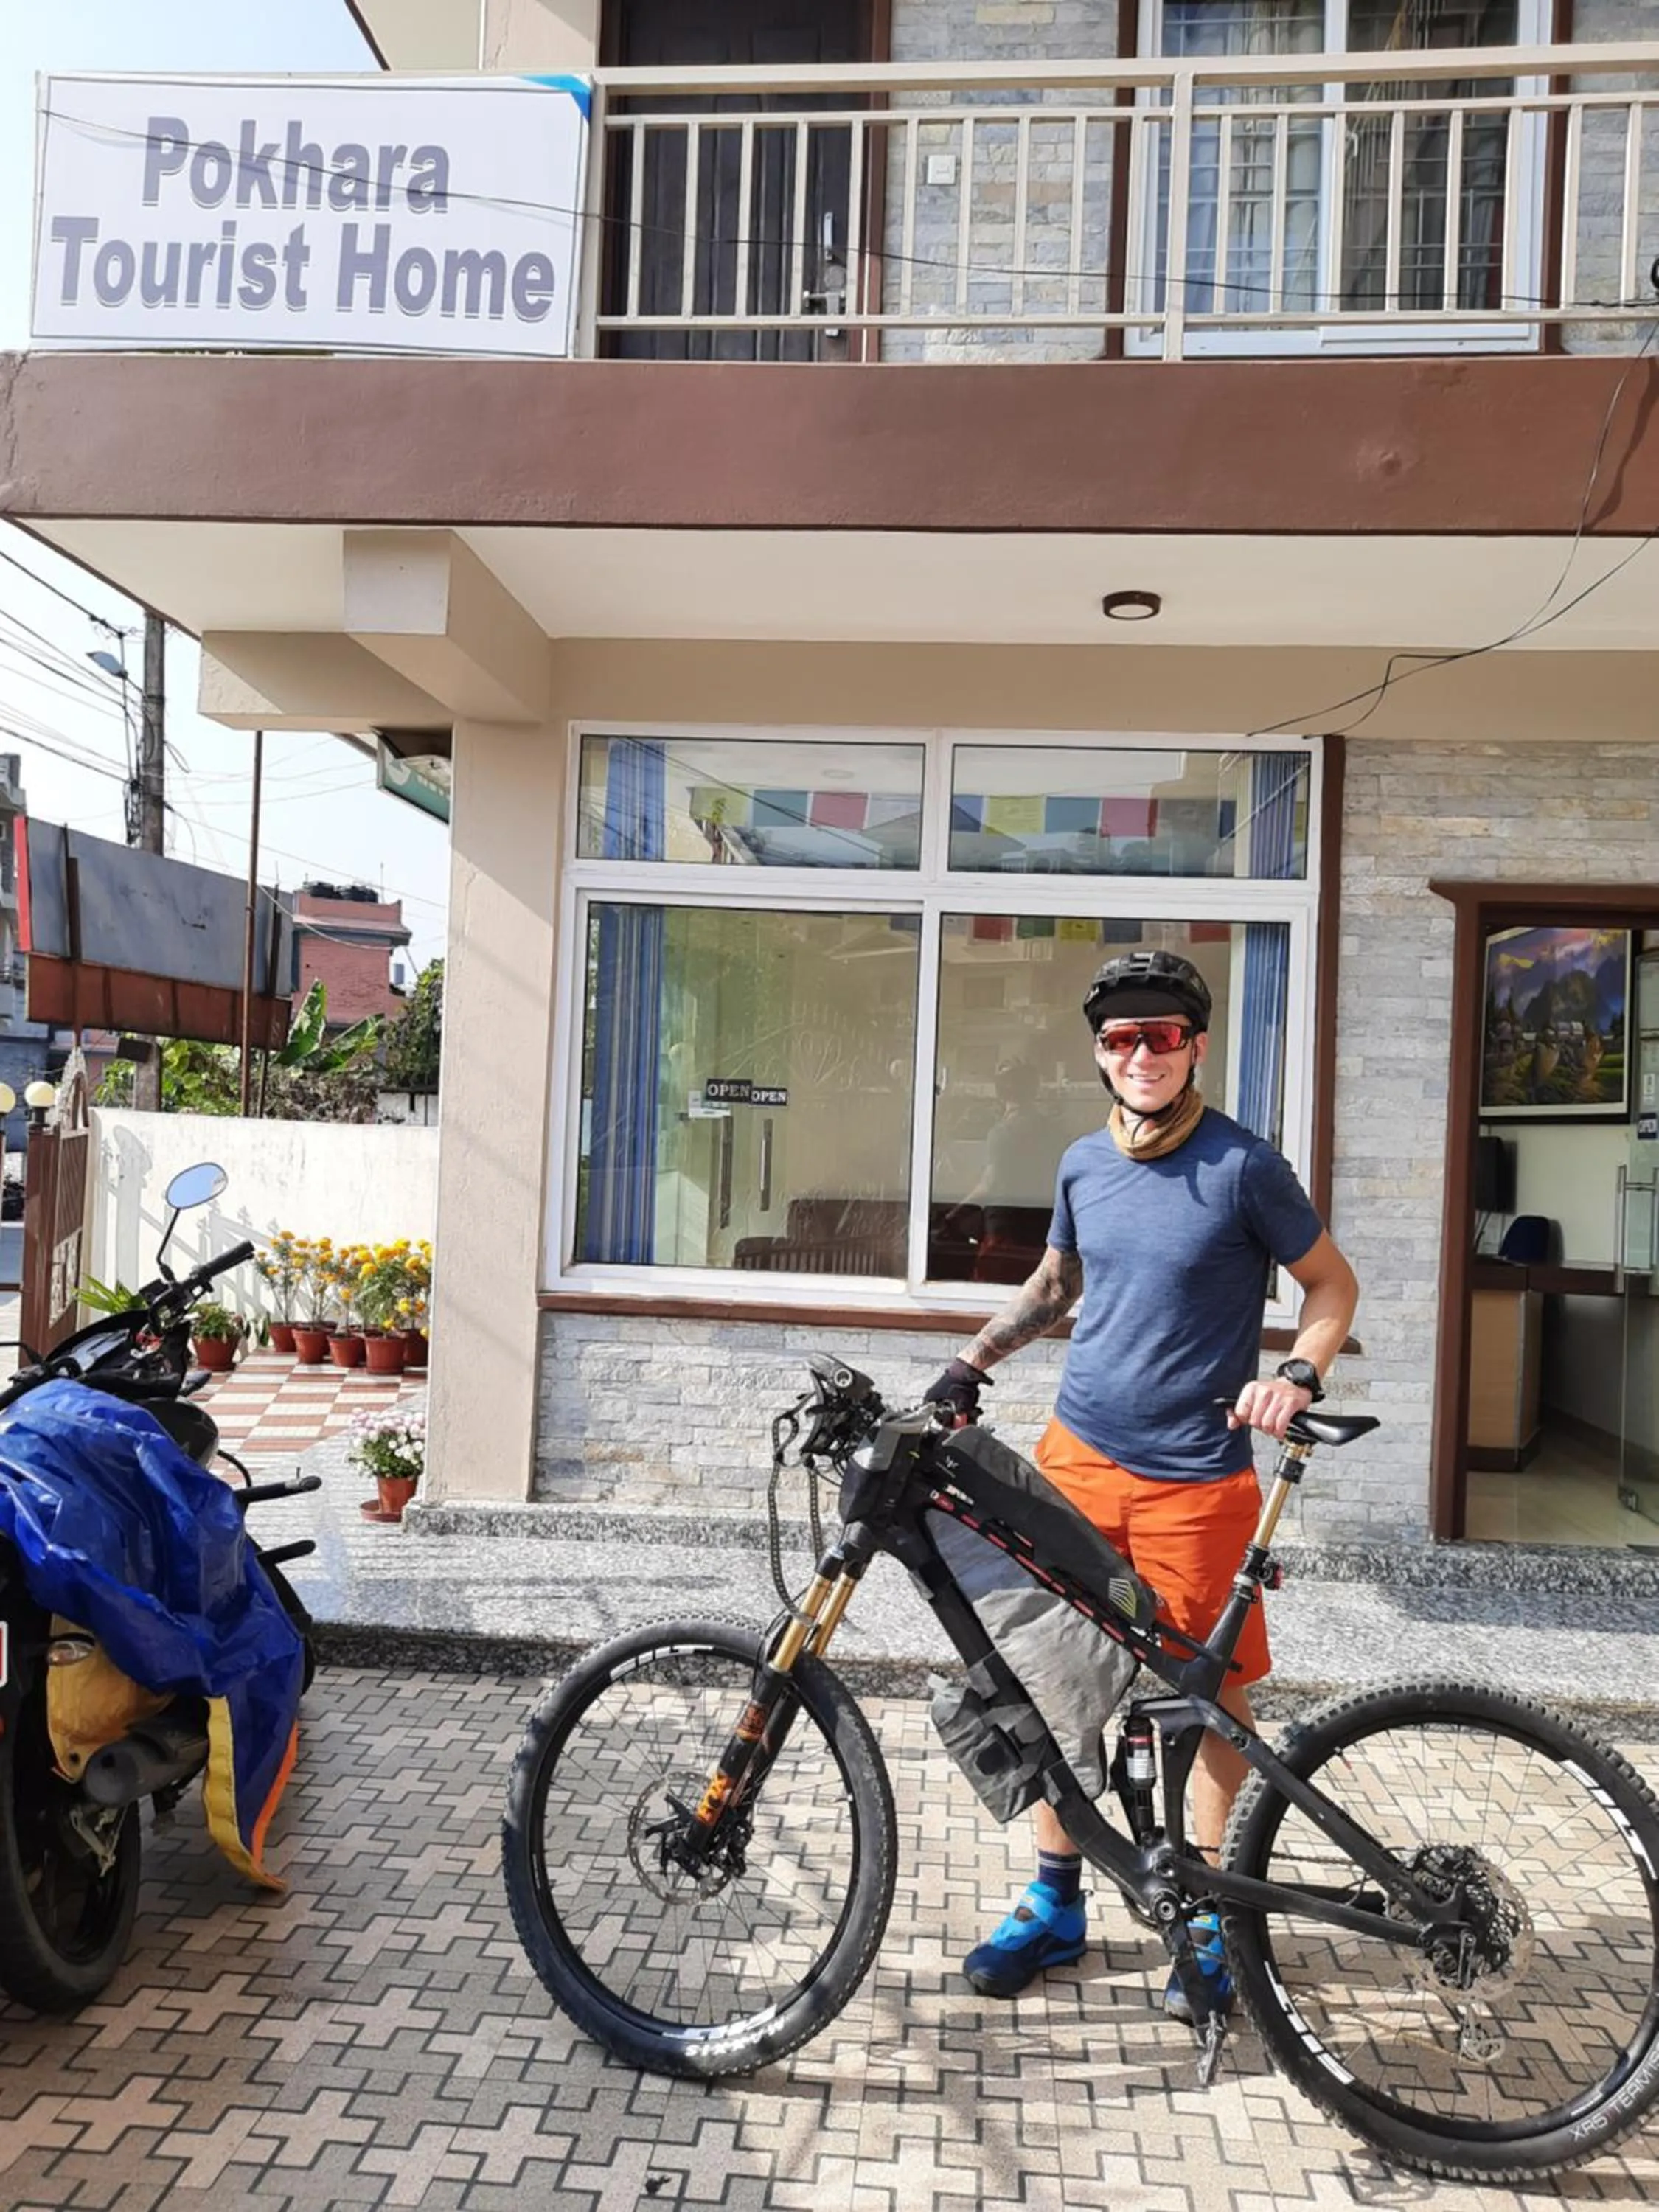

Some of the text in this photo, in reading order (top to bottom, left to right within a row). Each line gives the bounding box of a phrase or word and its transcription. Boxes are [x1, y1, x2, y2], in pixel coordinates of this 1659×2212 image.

[142, 116, 451, 213] Pokhara
[51, 216, 554, 322] Tourist Home
[707, 1083, 751, 1097] OPEN
[751, 1091, 787, 1102] OPEN
[1608, 2067, 1654, 2114] TEAM
